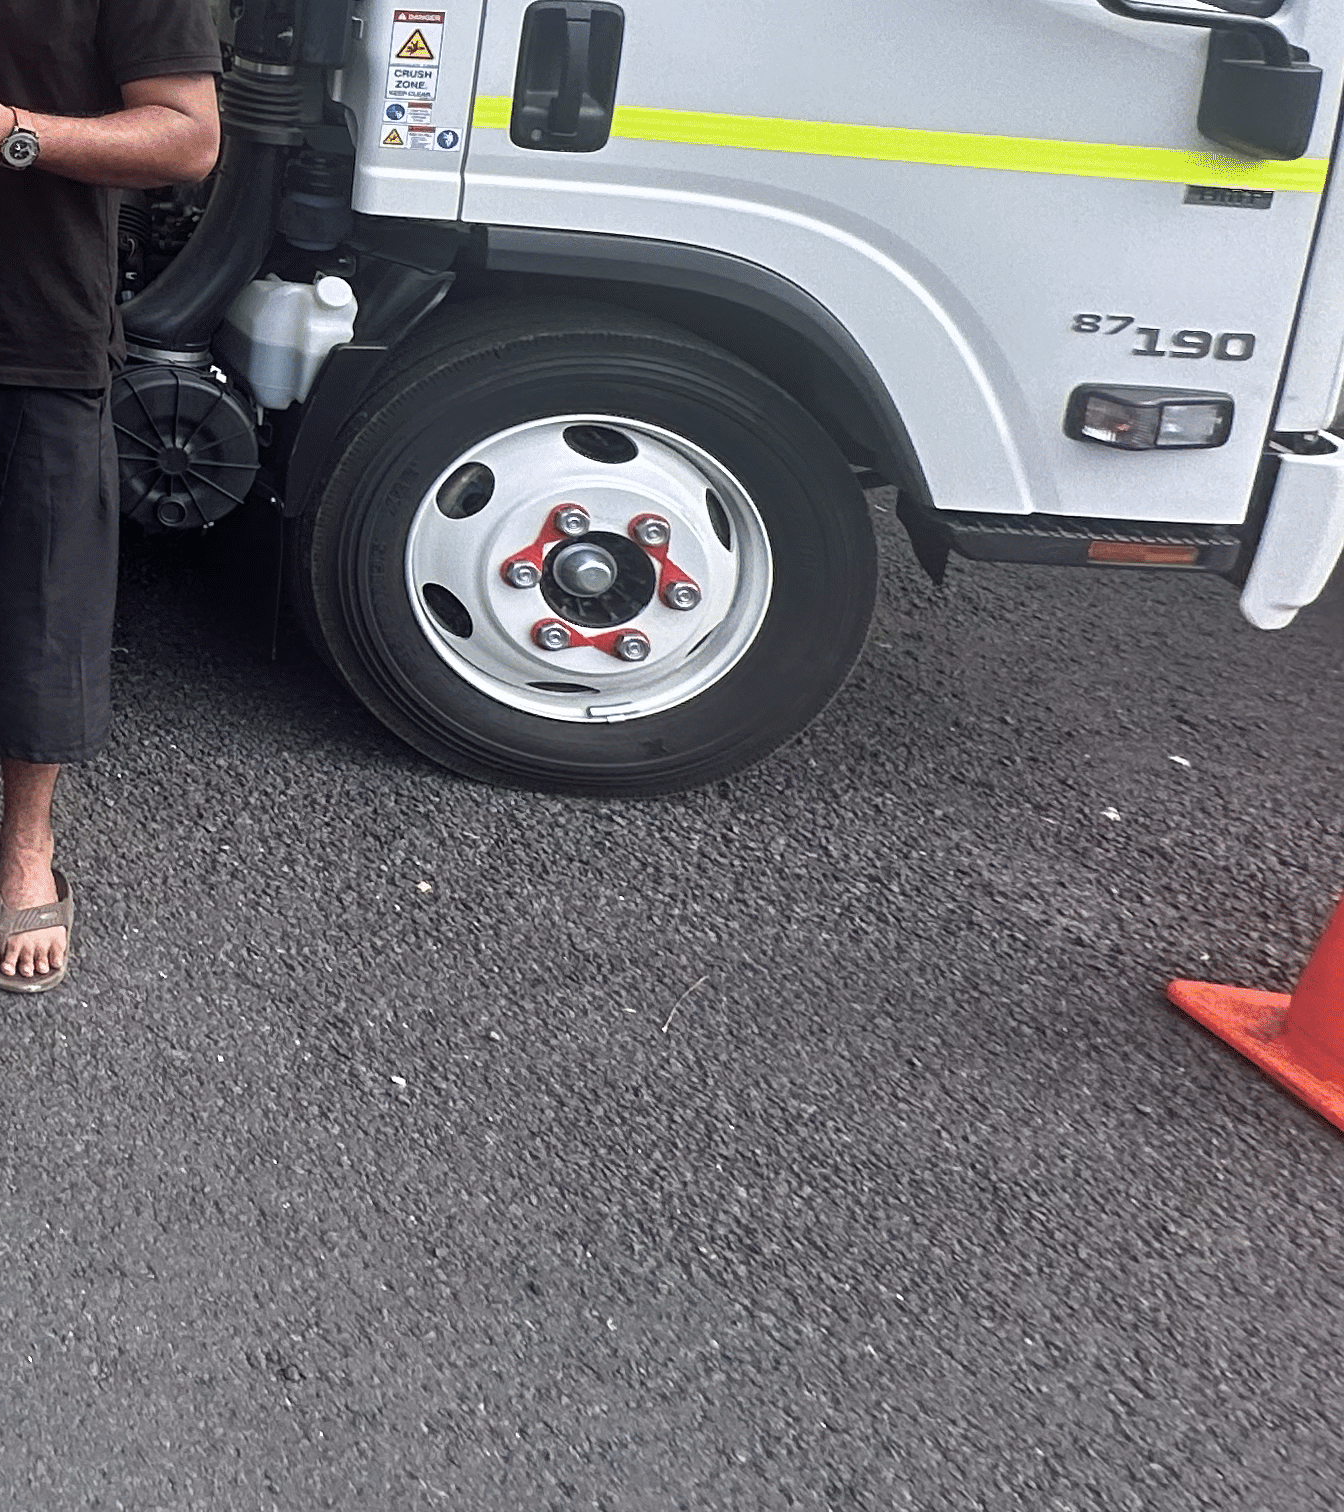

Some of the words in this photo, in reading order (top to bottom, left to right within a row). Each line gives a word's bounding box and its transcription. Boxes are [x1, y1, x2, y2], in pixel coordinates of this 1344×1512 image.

[393, 69, 433, 79] CRUSH
[394, 80, 427, 90] ZONE
[1071, 313, 1136, 335] 87
[1131, 326, 1256, 362] 190
